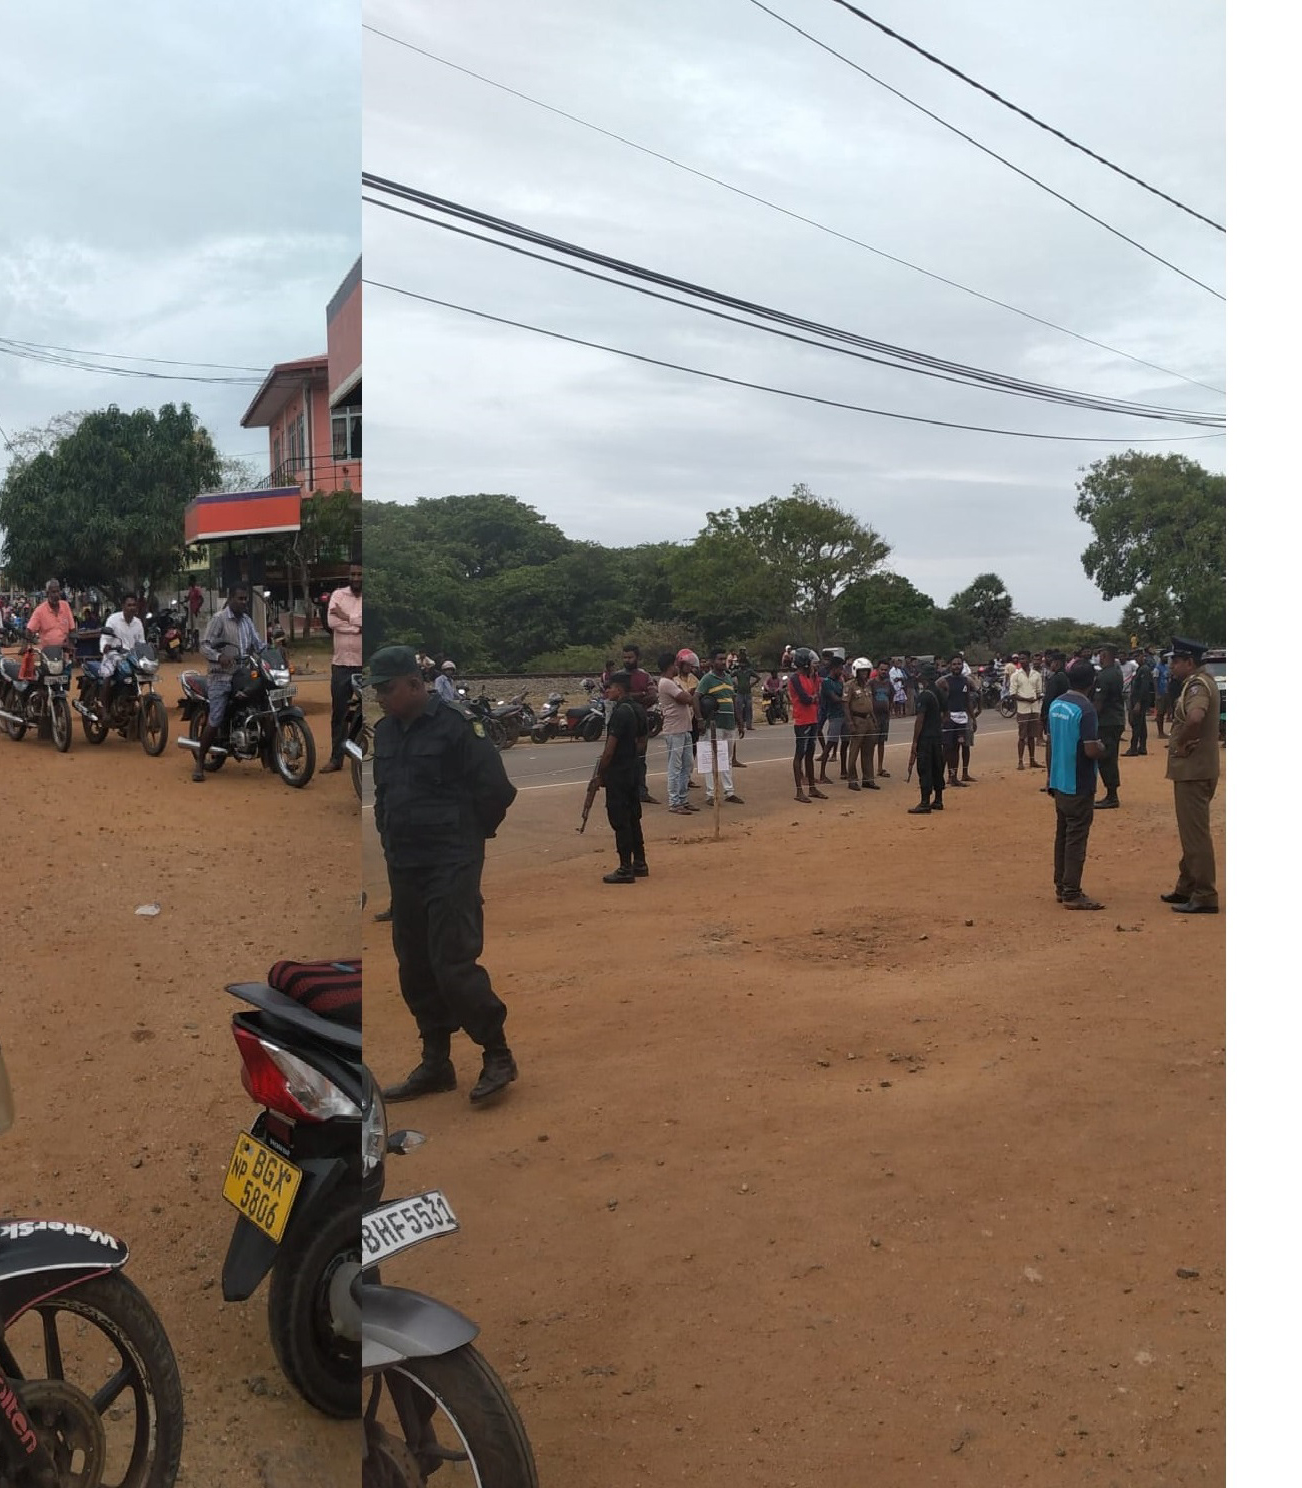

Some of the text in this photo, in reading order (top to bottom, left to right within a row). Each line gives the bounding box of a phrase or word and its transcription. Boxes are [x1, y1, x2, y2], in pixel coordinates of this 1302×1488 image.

[231, 1155, 248, 1180] NP
[240, 1180, 279, 1230] 5806
[362, 1196, 455, 1254] BHF5531
